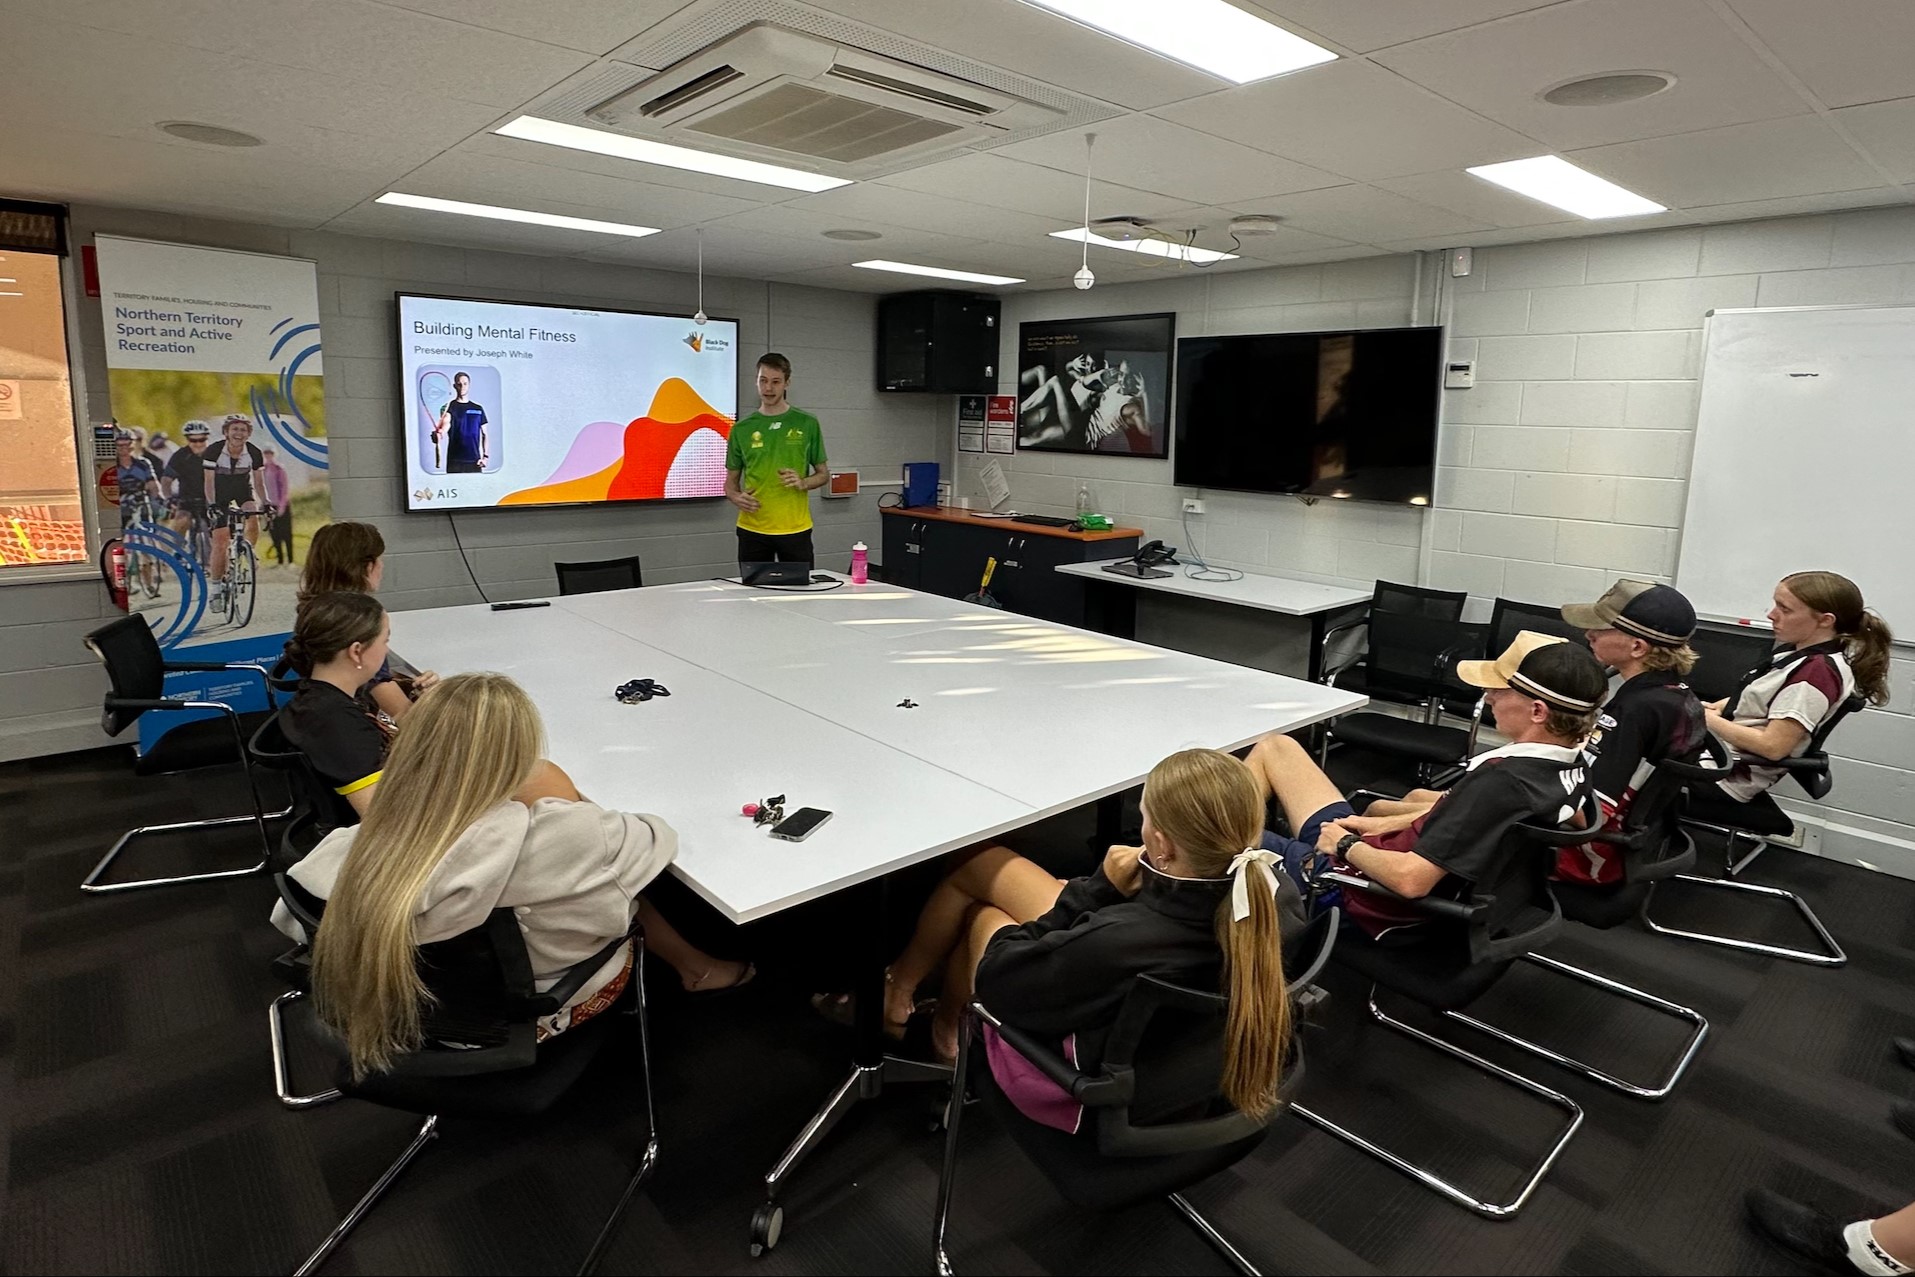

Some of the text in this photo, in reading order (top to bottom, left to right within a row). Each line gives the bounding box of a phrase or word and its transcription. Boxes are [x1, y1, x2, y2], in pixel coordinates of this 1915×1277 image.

[113, 292, 150, 301] TERRITORY
[115, 306, 243, 329] Northern Territory
[116, 323, 232, 341] Sport and Active
[413, 320, 577, 343] Building Mental Fitness
[118, 338, 196, 354] Recreation
[719, 339, 729, 347] Dog
[414, 345, 534, 360] Presented by Joseph White
[437, 488, 458, 499] AIS
